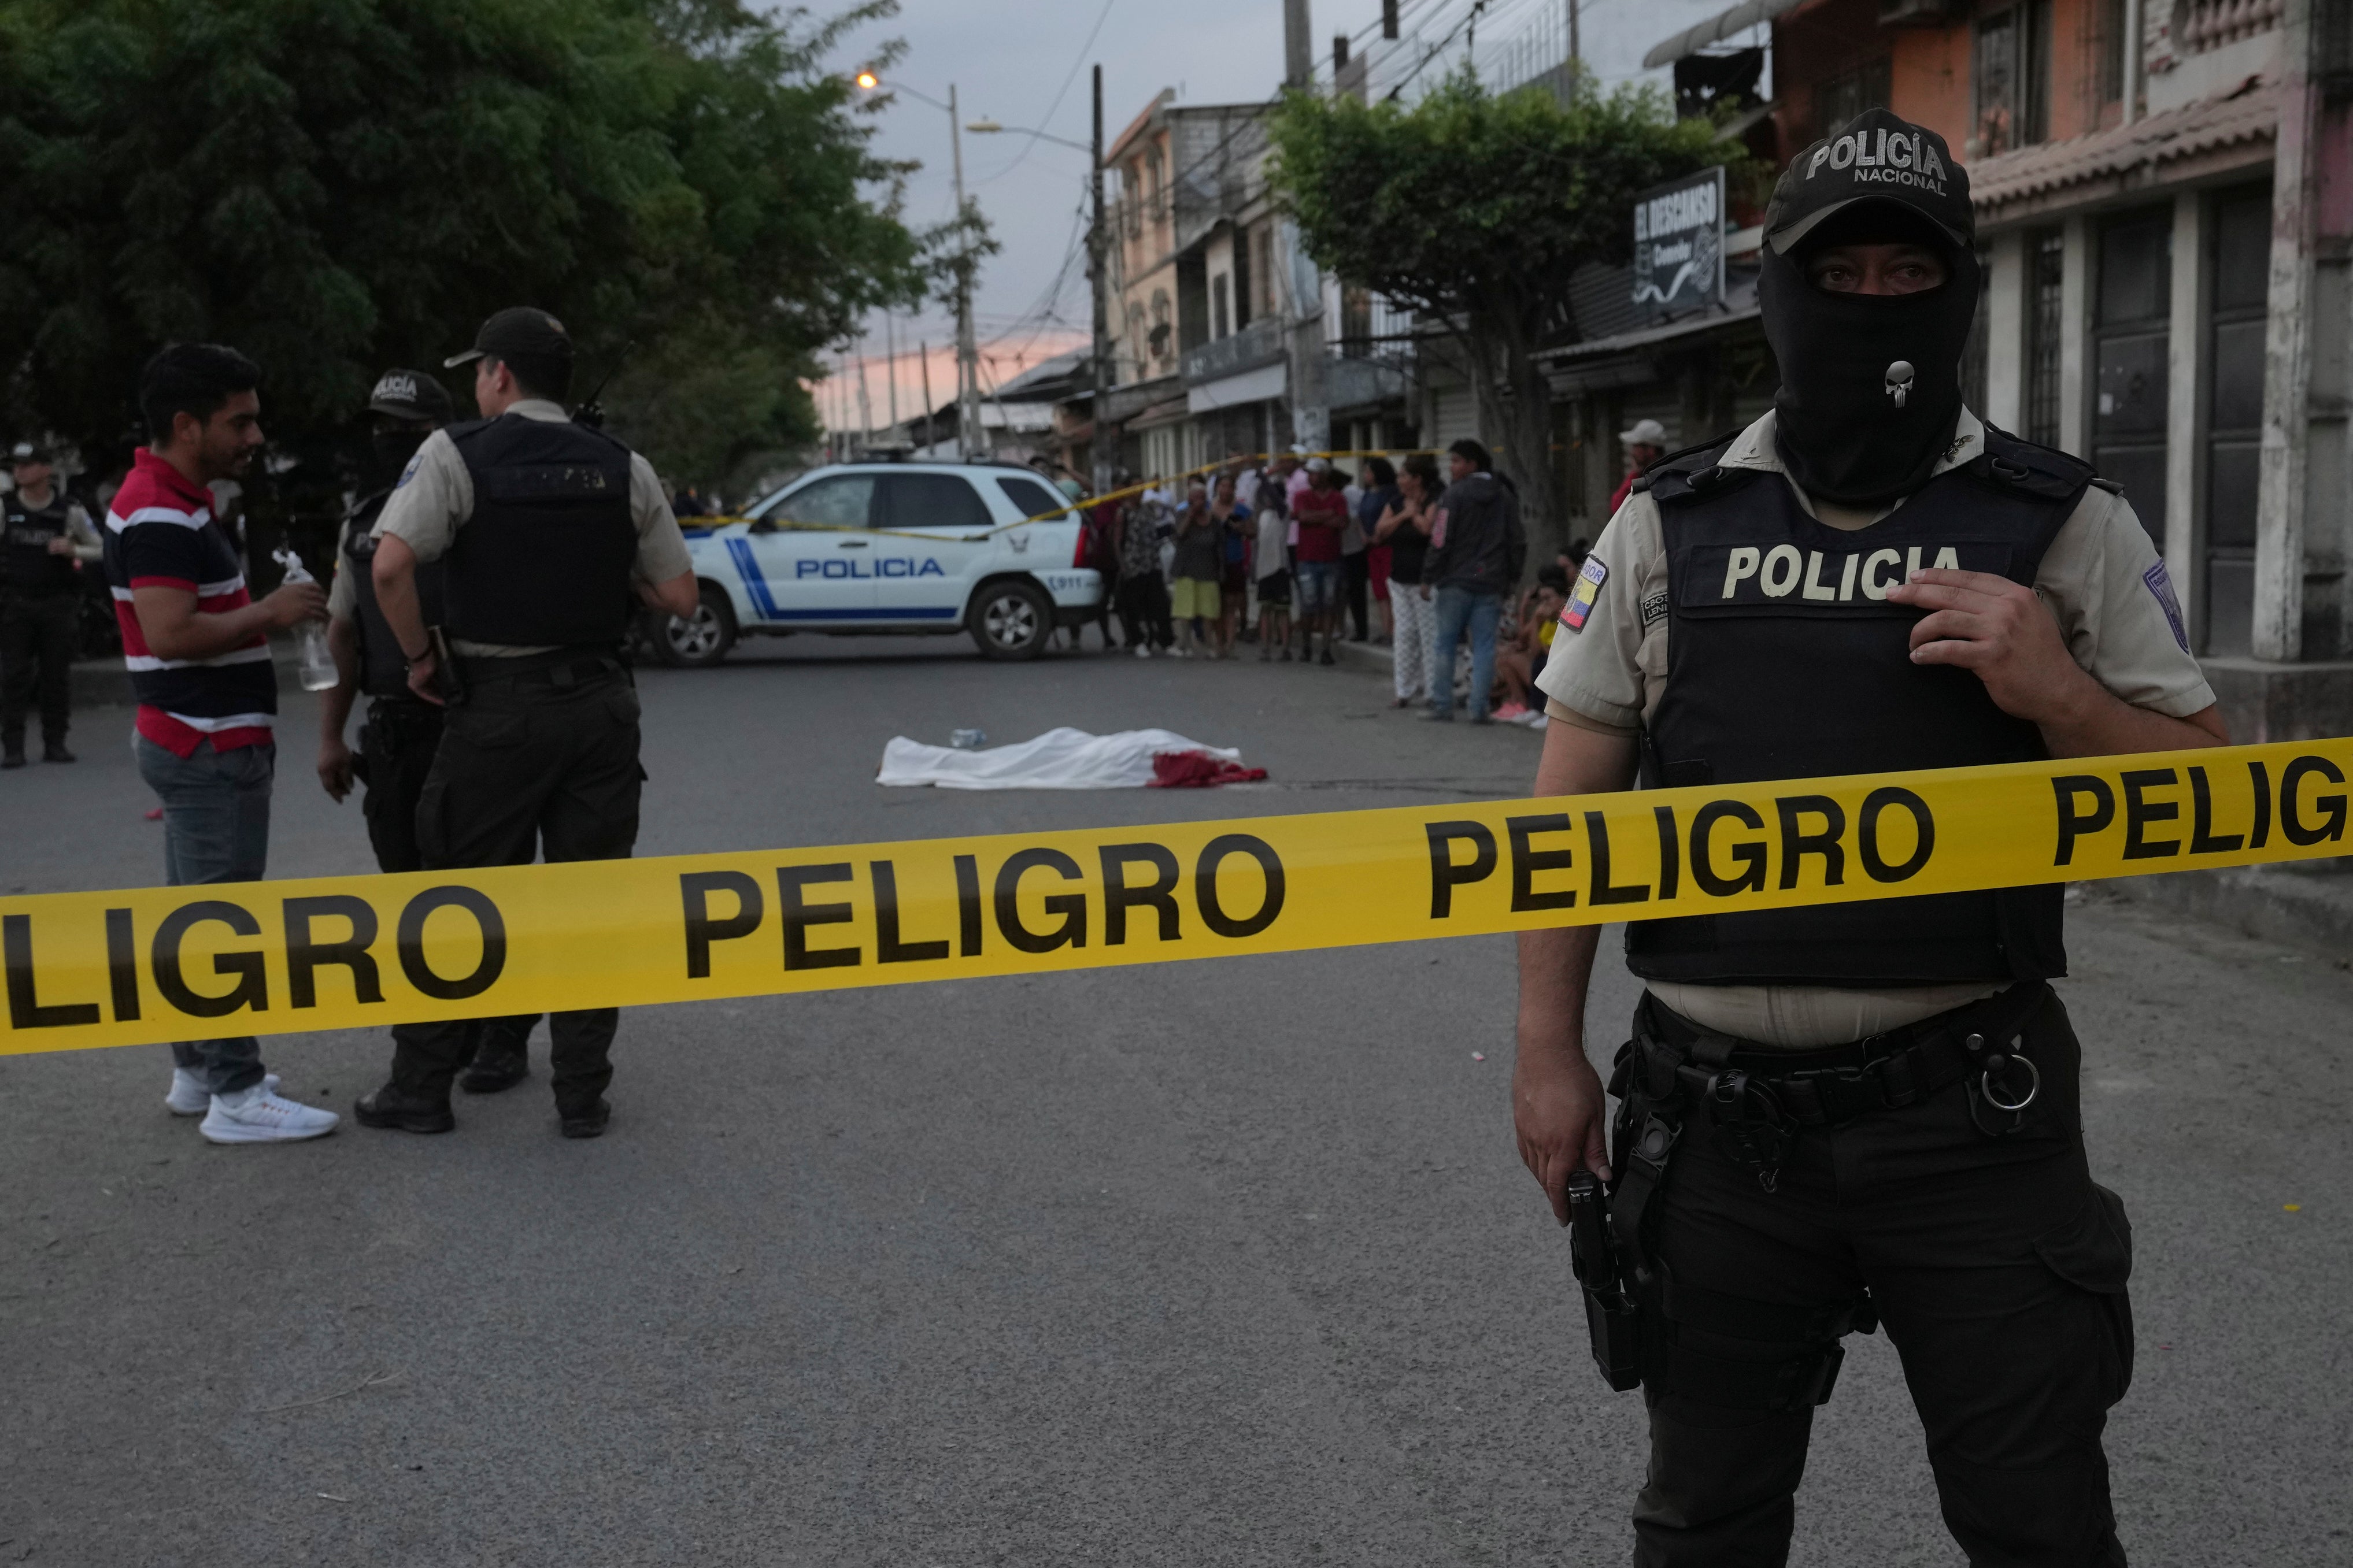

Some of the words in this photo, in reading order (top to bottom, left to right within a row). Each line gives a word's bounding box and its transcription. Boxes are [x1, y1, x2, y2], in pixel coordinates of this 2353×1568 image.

[1806, 128, 1947, 181] POLICÍA
[1854, 168, 1947, 197] NACIONAL
[1634, 203, 1648, 242] EL
[1649, 181, 1717, 239] DESCANSO
[2, 885, 506, 1029] LIGRO
[680, 833, 1285, 978] PELIGRO
[1425, 787, 1934, 918] PELIGRO
[2051, 755, 2347, 866] PELIG
